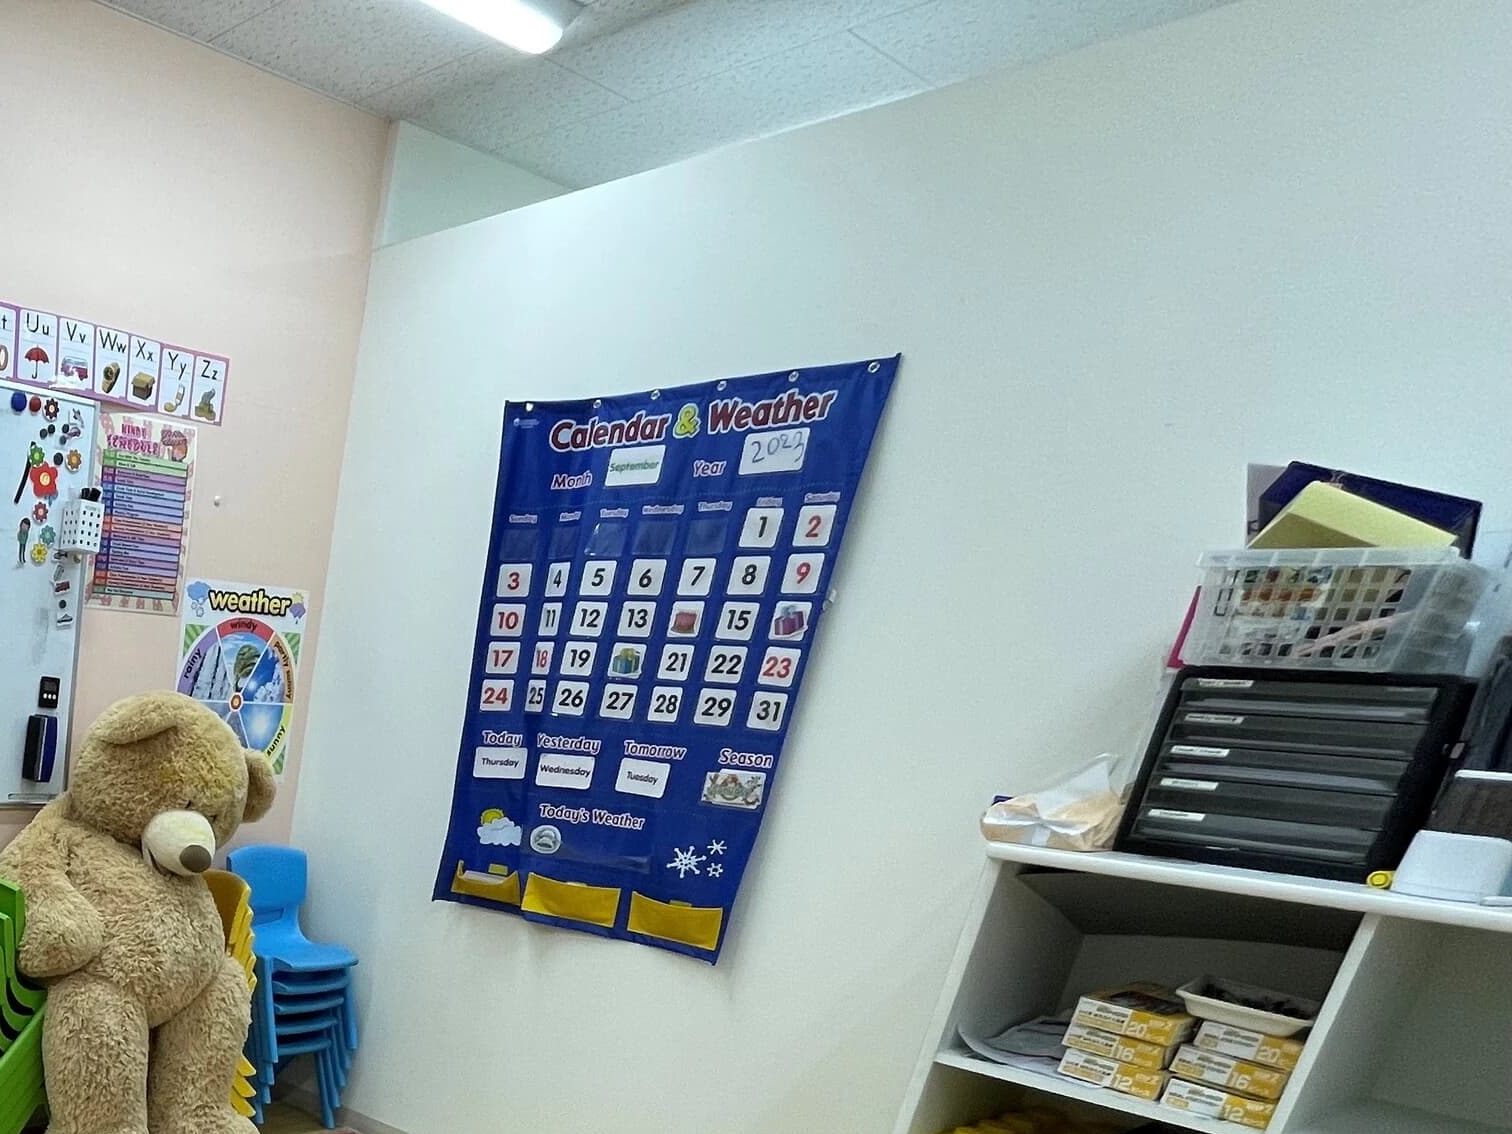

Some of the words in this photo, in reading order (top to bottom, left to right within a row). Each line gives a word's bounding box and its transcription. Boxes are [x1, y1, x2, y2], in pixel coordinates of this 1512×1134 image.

[549, 410, 672, 452] Calendar
[673, 403, 701, 439] &
[708, 388, 838, 435] Weather
[107, 434, 159, 455] SCHEDULE
[751, 431, 804, 463] 2023
[609, 461, 659, 474] September
[693, 460, 726, 477] Year
[759, 516, 768, 538] 1
[805, 515, 822, 538] 2
[507, 572, 520, 590] 3
[553, 569, 562, 588] 4
[591, 568, 606, 586] 5
[638, 568, 652, 588] 6
[691, 567, 706, 586] 7
[741, 564, 757, 585] 8
[796, 562, 811, 584] 9
[208, 589, 292, 617] weather
[230, 620, 258, 632] windy
[498, 611, 519, 629] 10
[545, 609, 556, 627] 11
[580, 608, 601, 627] 12
[628, 609, 648, 627] 13
[726, 610, 751, 630] 15
[183, 649, 203, 680] rainy
[274, 641, 289, 667] partly
[492, 649, 514, 667] 17
[536, 648, 548, 668] 18
[570, 648, 591, 668] 19
[666, 652, 687, 672] 21
[711, 654, 742, 674] 22
[763, 656, 791, 678] 23
[483, 687, 507, 704] 24
[529, 686, 543, 705] 25
[560, 689, 583, 707] 26
[606, 692, 634, 711] 27
[654, 694, 677, 714] 28
[702, 697, 732, 718] 29
[756, 700, 781, 722] 31
[266, 726, 286, 756] sunny
[482, 730, 522, 748] Today
[537, 733, 601, 754] Yesterday
[624, 740, 687, 760] Tomorrow
[718, 748, 774, 769] Season
[481, 757, 520, 769] Thursday
[540, 763, 591, 778] Wednesday
[627, 771, 658, 785] Tuesday
[540, 804, 590, 823] Today's
[592, 811, 645, 830] Weather
[1128, 1021, 1147, 1036] 20
[1115, 1074, 1133, 1088] 12
[1228, 1071, 1251, 1090] 16
[1223, 1105, 1244, 1121] 12
